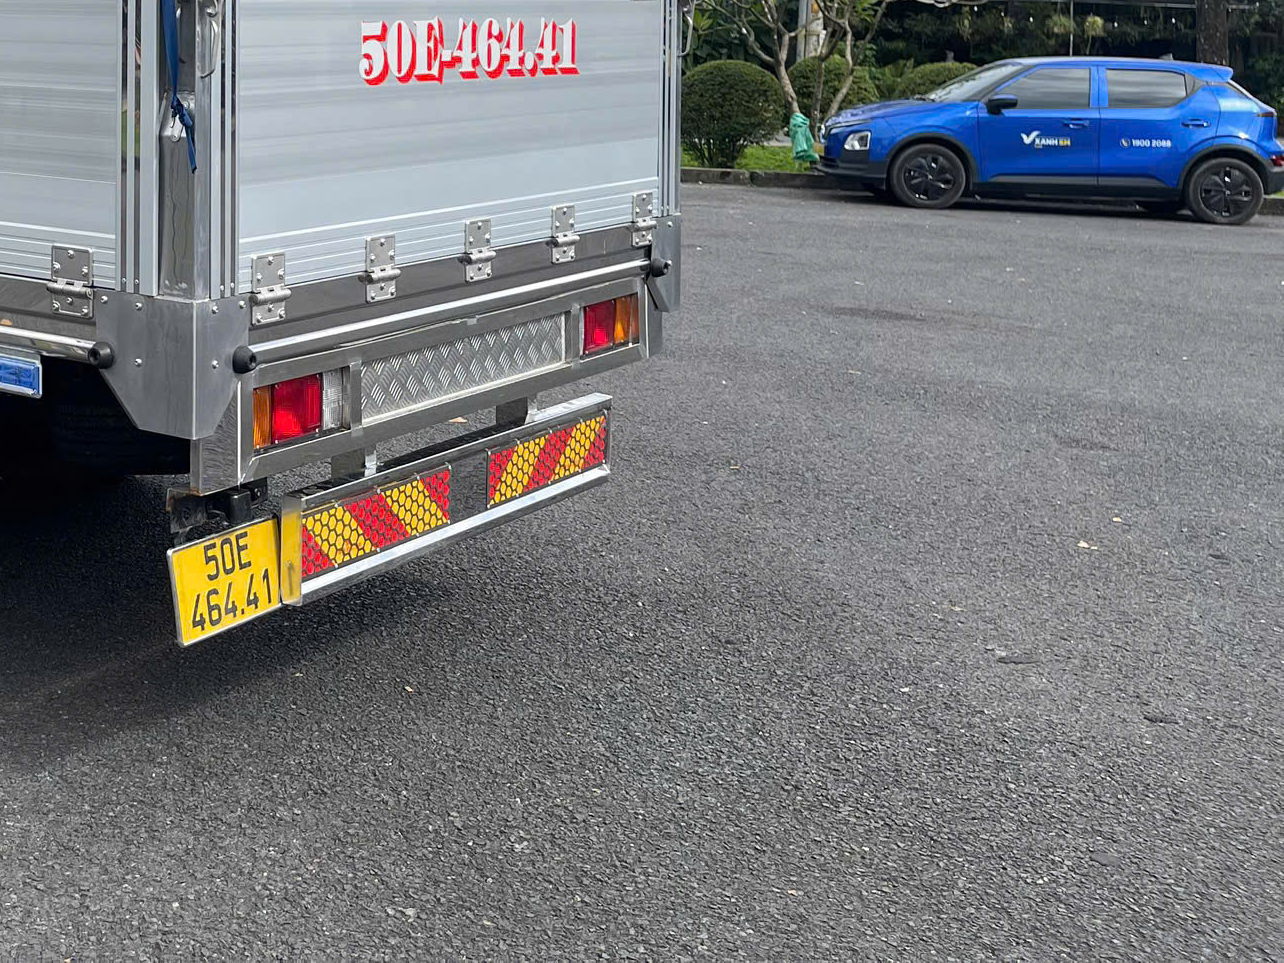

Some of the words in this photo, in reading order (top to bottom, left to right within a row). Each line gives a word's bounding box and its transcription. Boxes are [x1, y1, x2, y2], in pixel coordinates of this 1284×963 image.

[358, 15, 580, 86] 50E-464.41
[1131, 138, 1150, 147] 1900
[203, 531, 252, 581] 50E
[191, 568, 272, 631] 464.41
